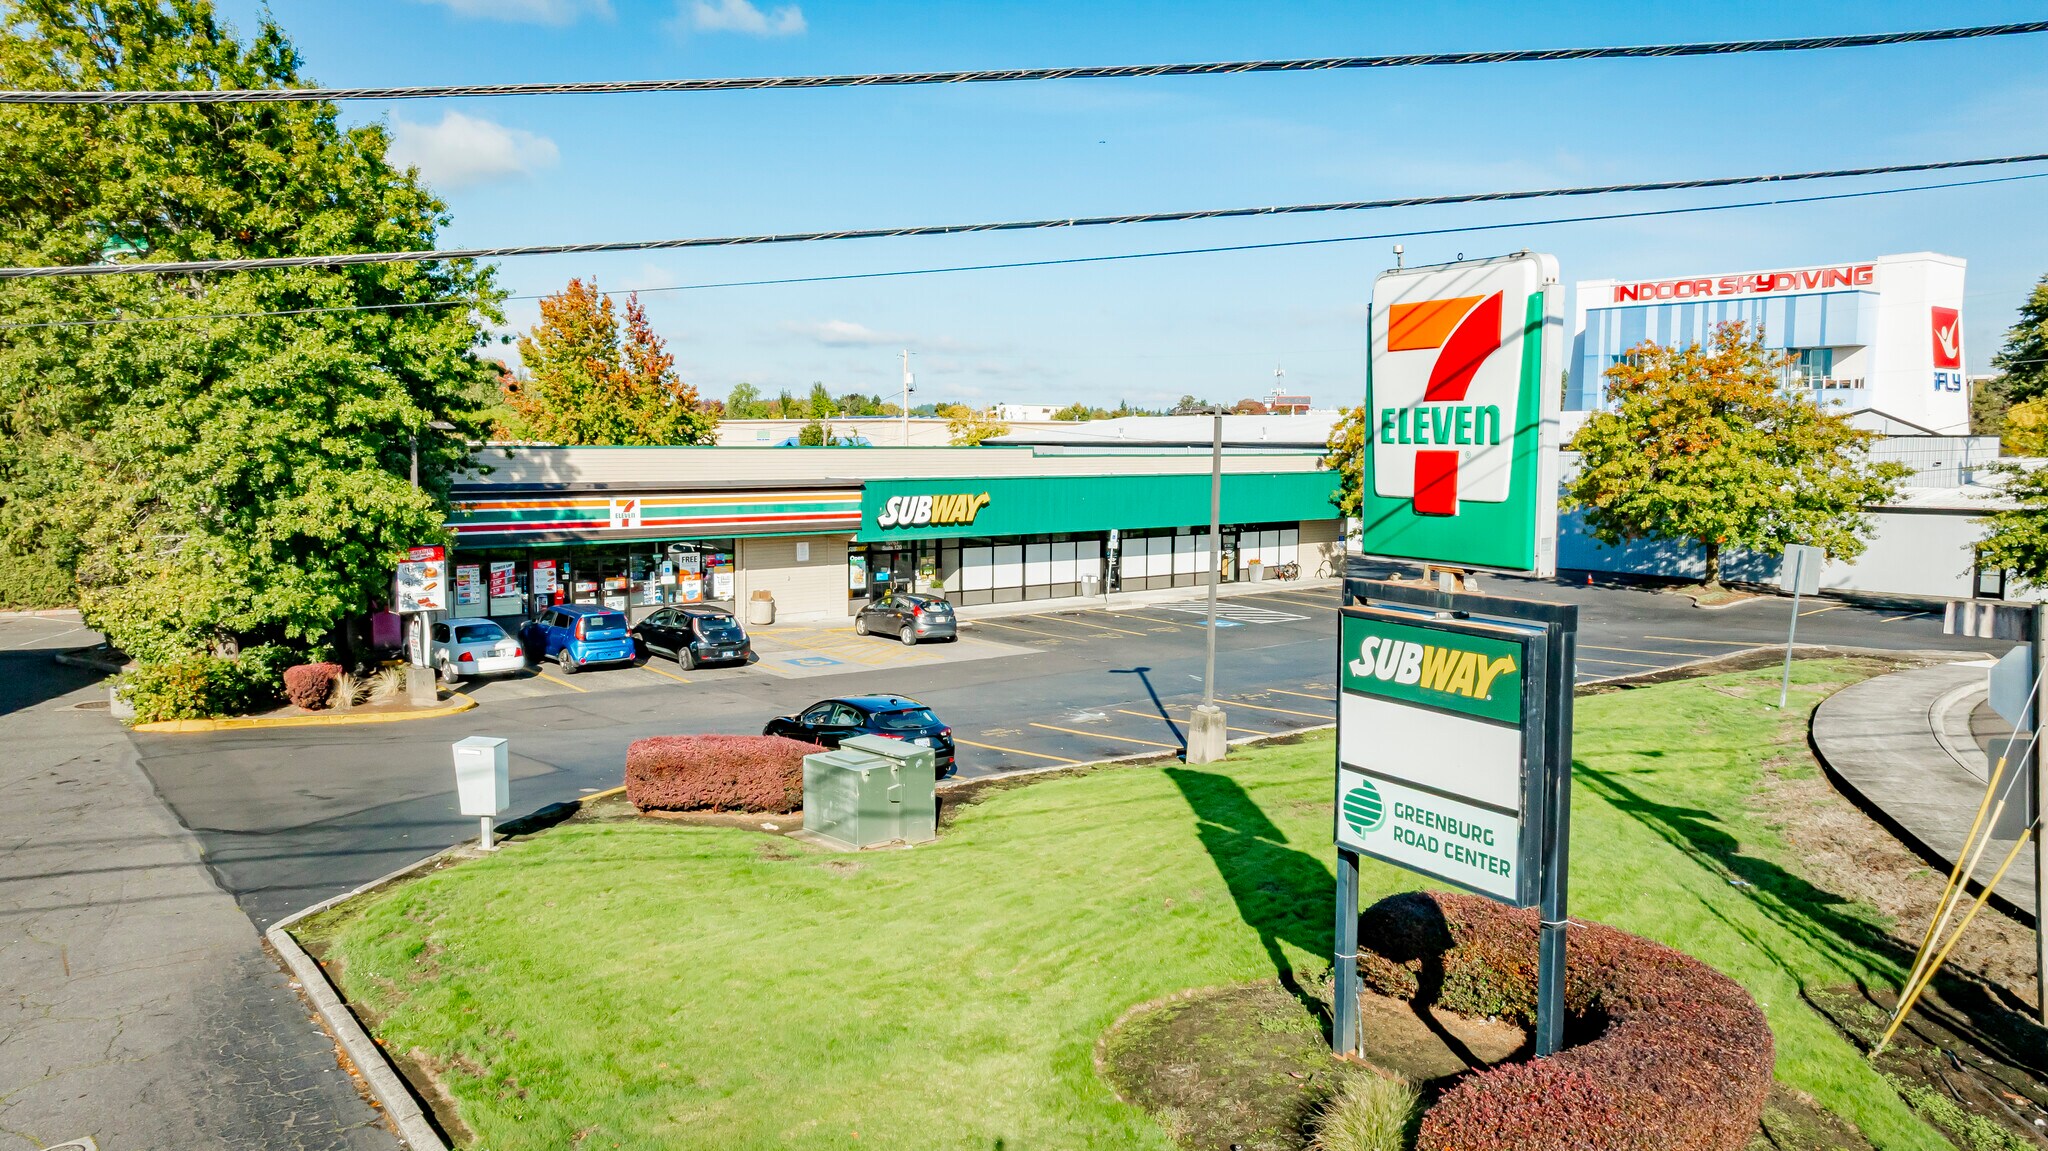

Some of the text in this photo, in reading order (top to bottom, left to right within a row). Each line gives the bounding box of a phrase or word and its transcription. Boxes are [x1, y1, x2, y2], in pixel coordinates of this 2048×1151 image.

[1614, 265, 1874, 303] INDOOR SKYDIVING
[1387, 289, 1504, 516] 7
[615, 499, 635, 528] 7
[877, 491, 990, 528] SUBWAY
[681, 555, 698, 564] FREE
[1348, 635, 1518, 700] SUBWAY
[1393, 802, 1495, 847] GREENBURG
[1393, 826, 1512, 879] ROAD CENTER
